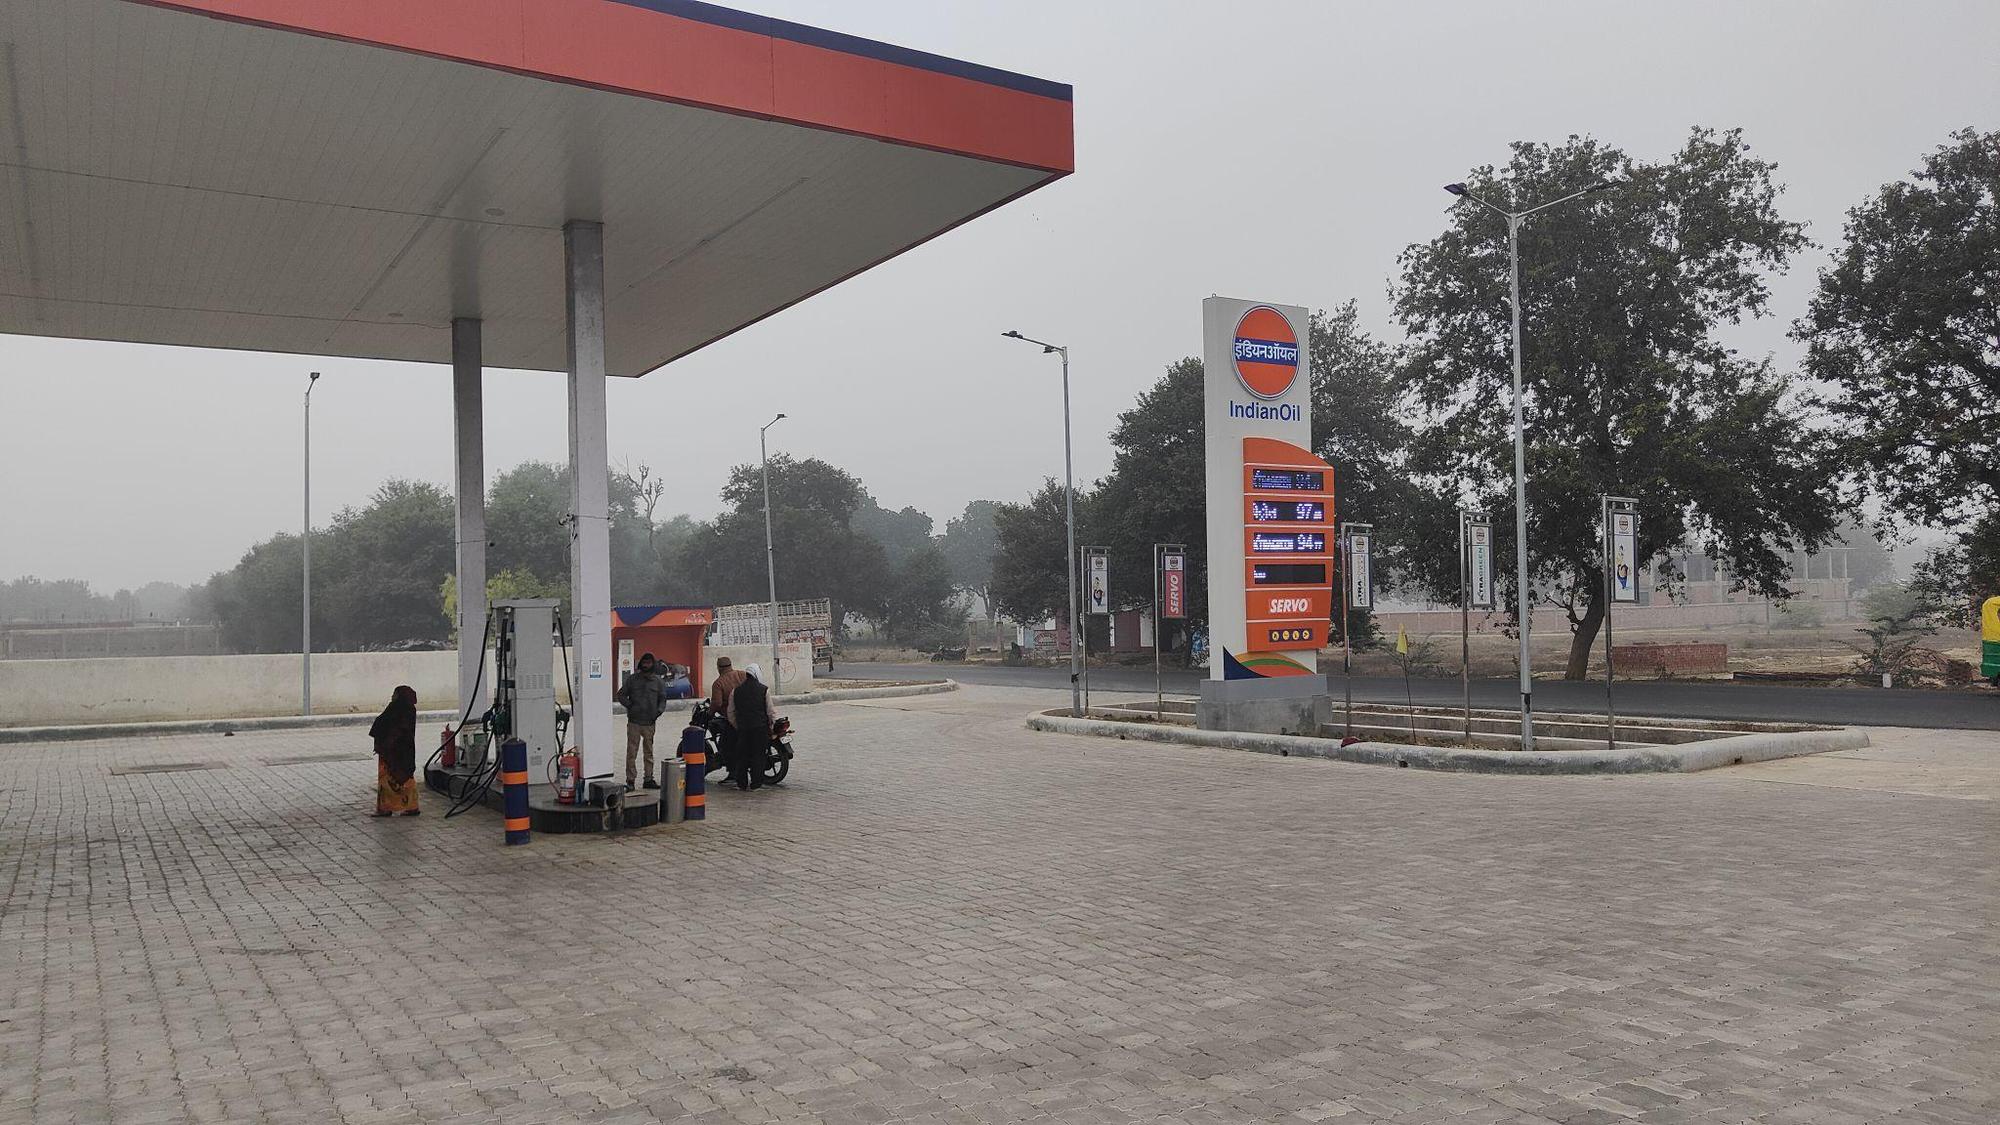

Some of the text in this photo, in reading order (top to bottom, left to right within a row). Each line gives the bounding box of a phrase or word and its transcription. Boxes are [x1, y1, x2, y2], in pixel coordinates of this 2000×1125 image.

[1235, 340, 1297, 361] इंडियनऑयल
[1230, 400, 1300, 421] IndianOil
[1170, 575, 1179, 614] SERVO
[1270, 598, 1309, 613] SERVO
